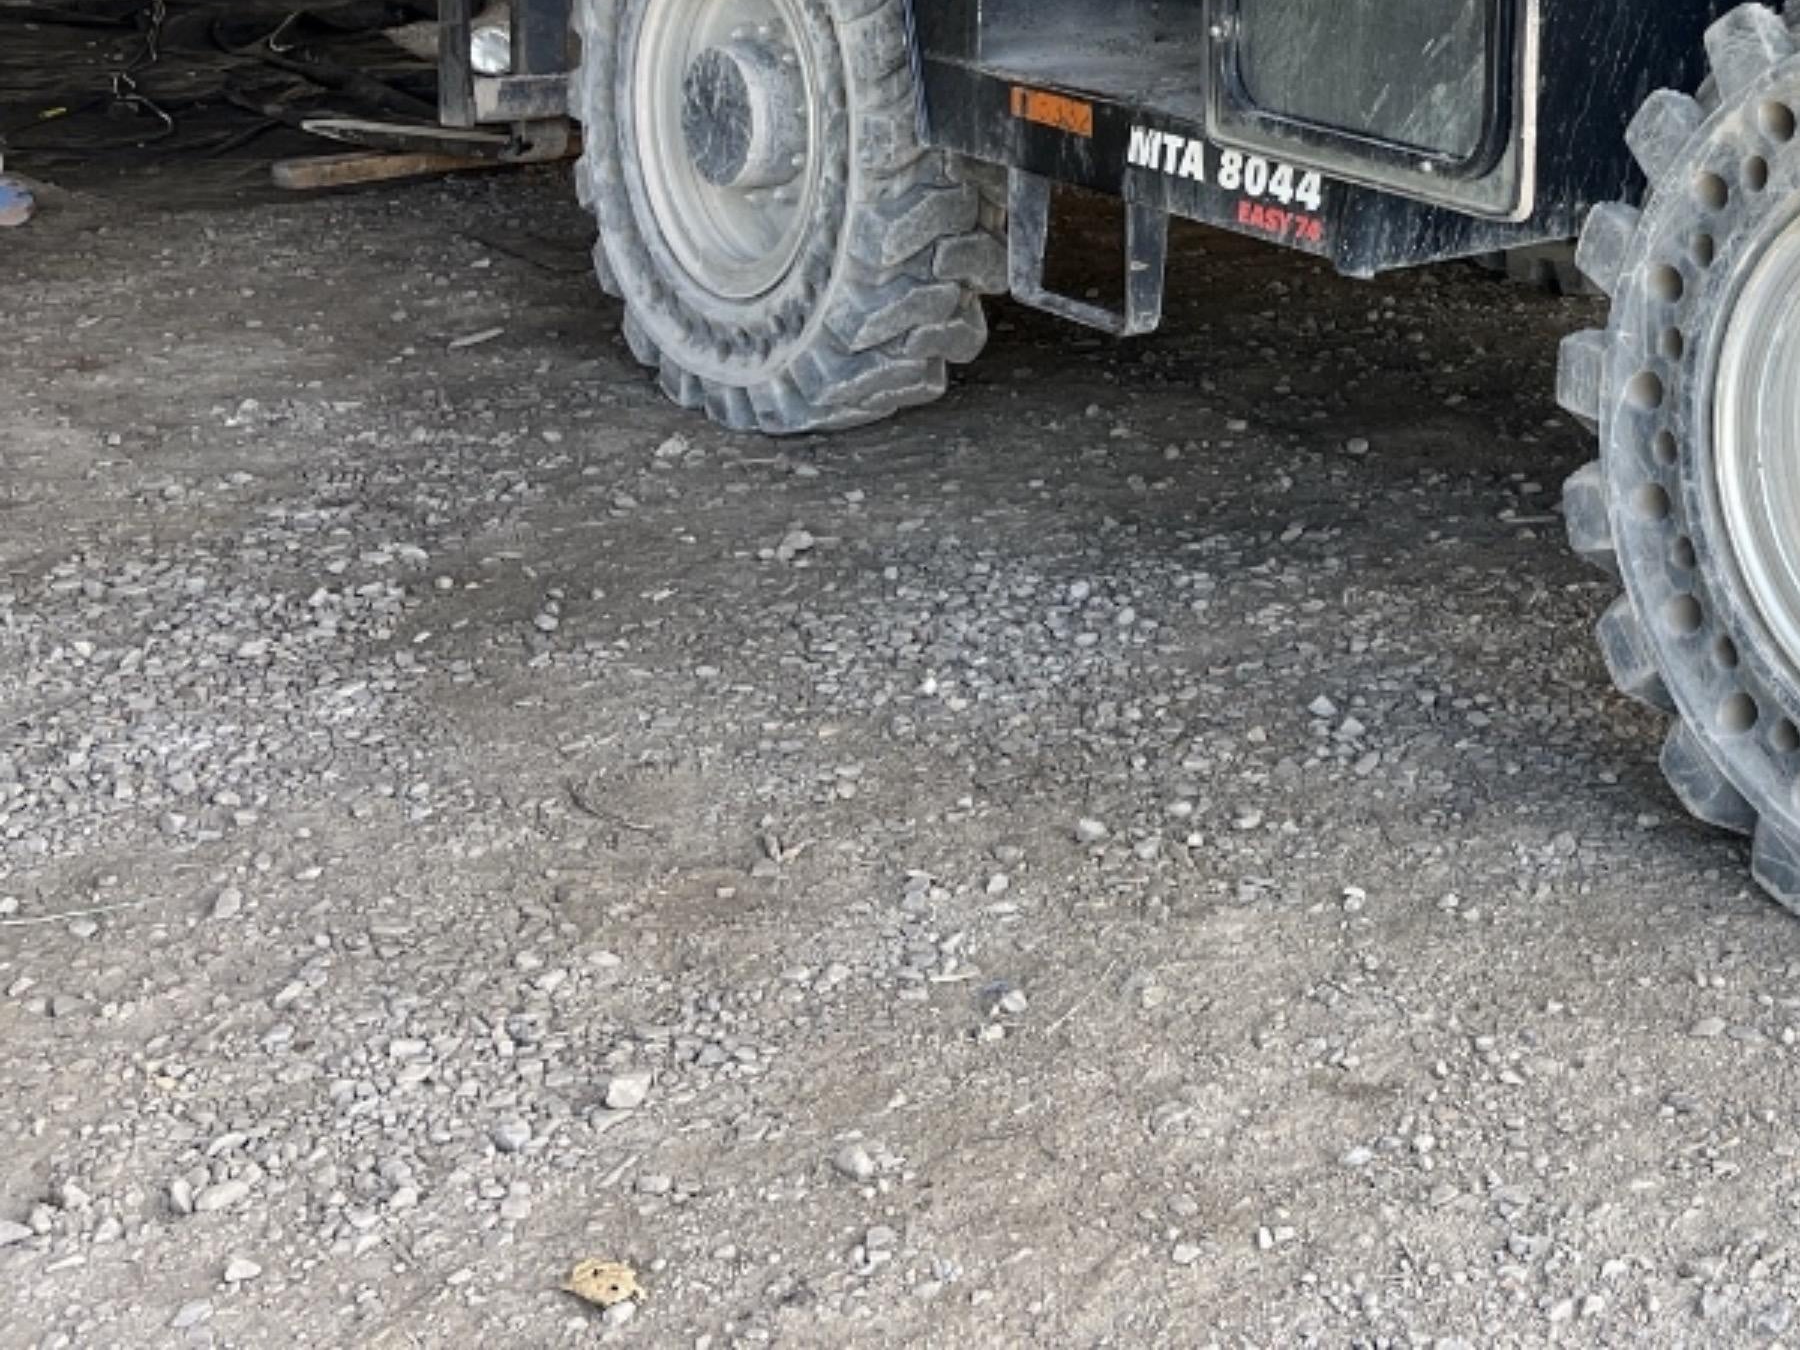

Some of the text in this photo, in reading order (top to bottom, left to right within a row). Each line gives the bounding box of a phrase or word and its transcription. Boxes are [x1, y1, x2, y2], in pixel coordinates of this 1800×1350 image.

[1127, 125, 1321, 211] MTA 8044
[1237, 198, 1293, 238] EASY
